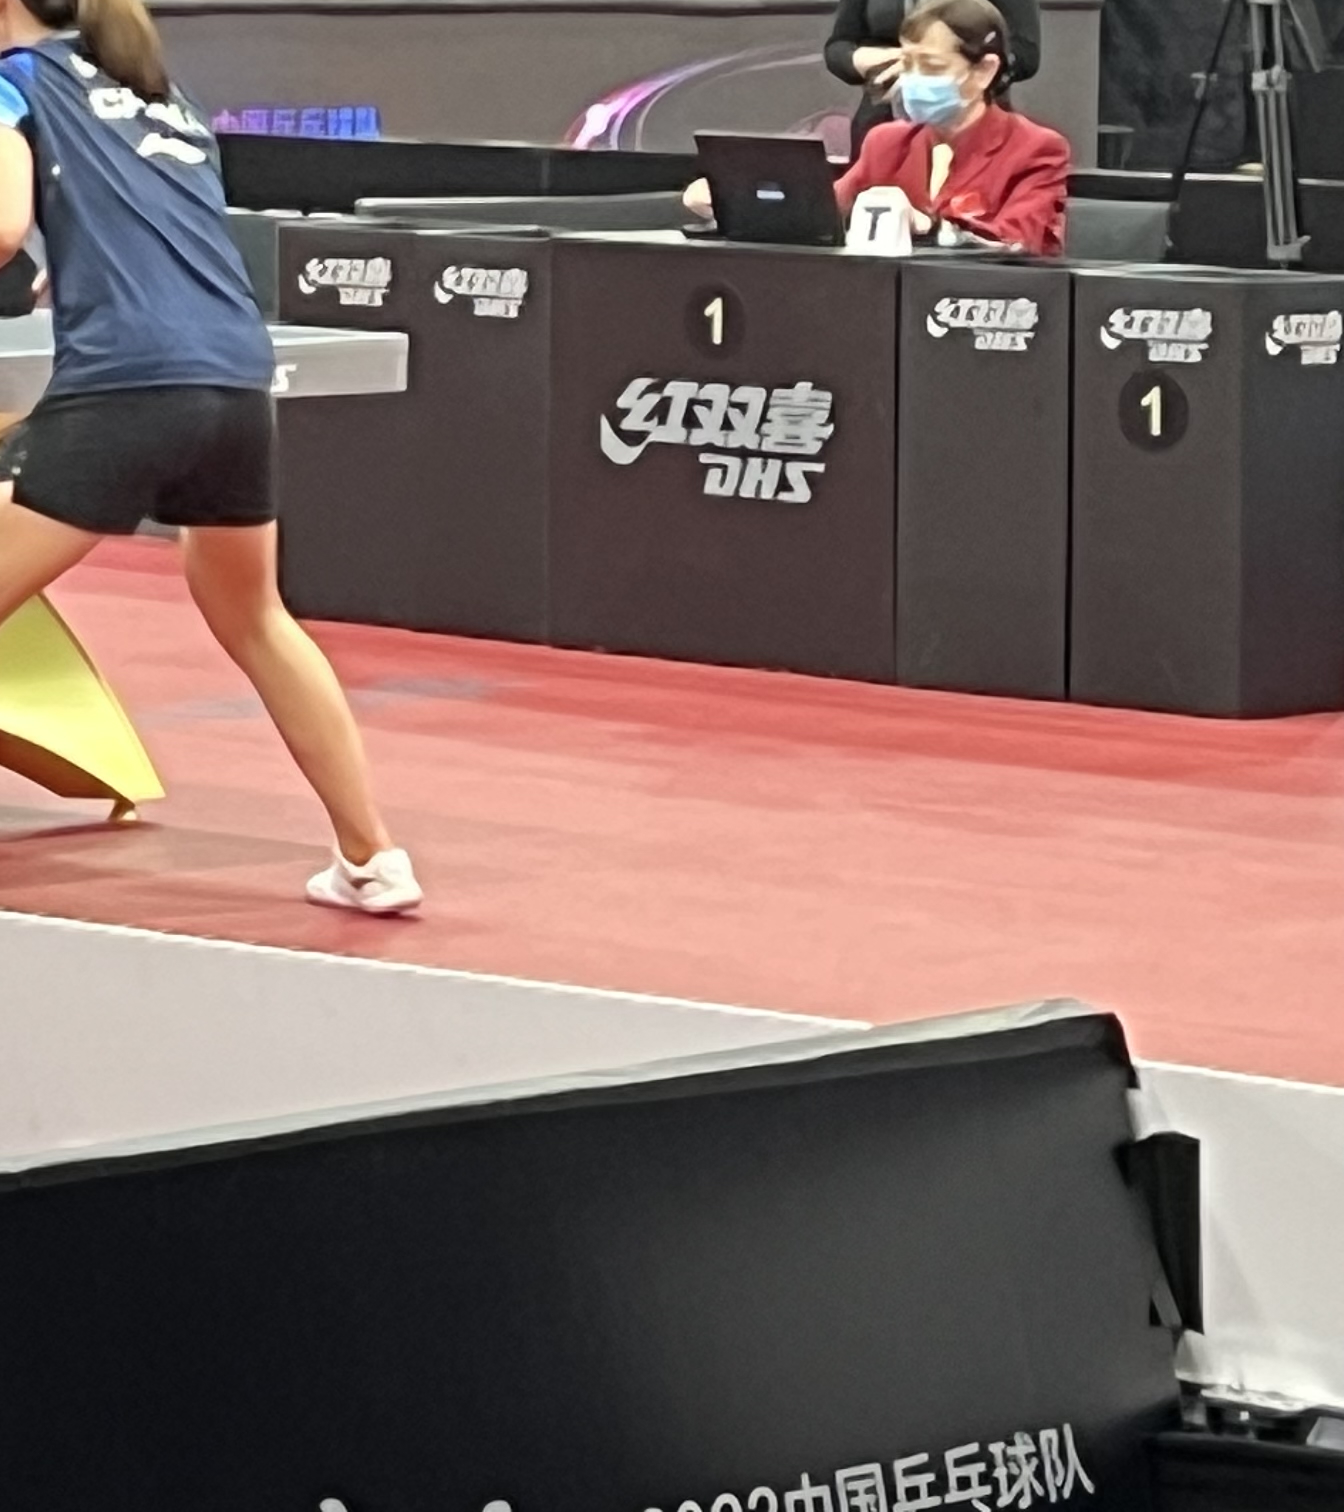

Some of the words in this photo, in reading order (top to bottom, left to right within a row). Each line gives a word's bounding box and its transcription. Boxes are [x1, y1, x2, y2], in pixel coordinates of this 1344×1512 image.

[703, 296, 724, 346] 1
[599, 377, 835, 466] 红双喜
[1140, 384, 1163, 437] 1
[698, 452, 826, 504] DHS
